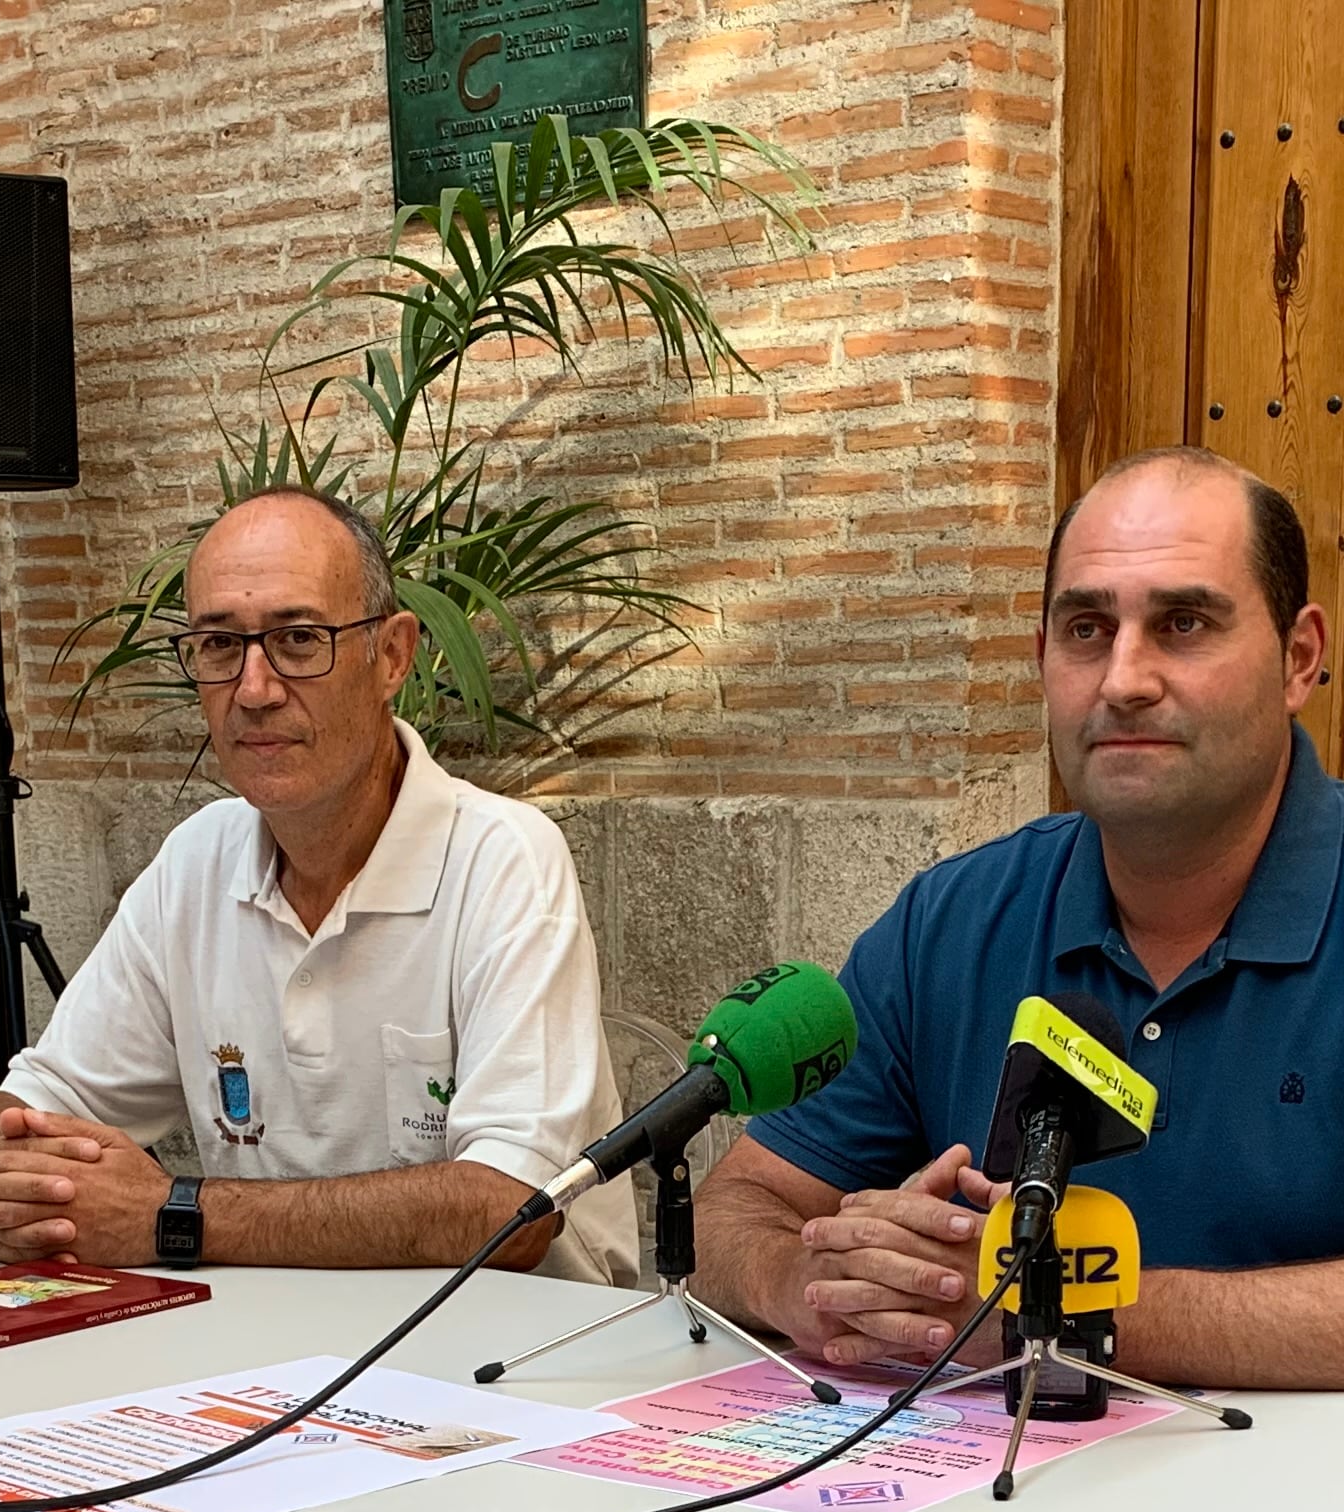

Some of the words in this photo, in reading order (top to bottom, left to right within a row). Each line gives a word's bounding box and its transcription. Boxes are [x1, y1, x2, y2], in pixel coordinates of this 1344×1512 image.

[523, 24, 572, 44] TURISMO
[400, 72, 450, 96] PREMIO
[1046, 1026, 1143, 1110] telemedina
[557, 1452, 733, 1491] Campeonato
